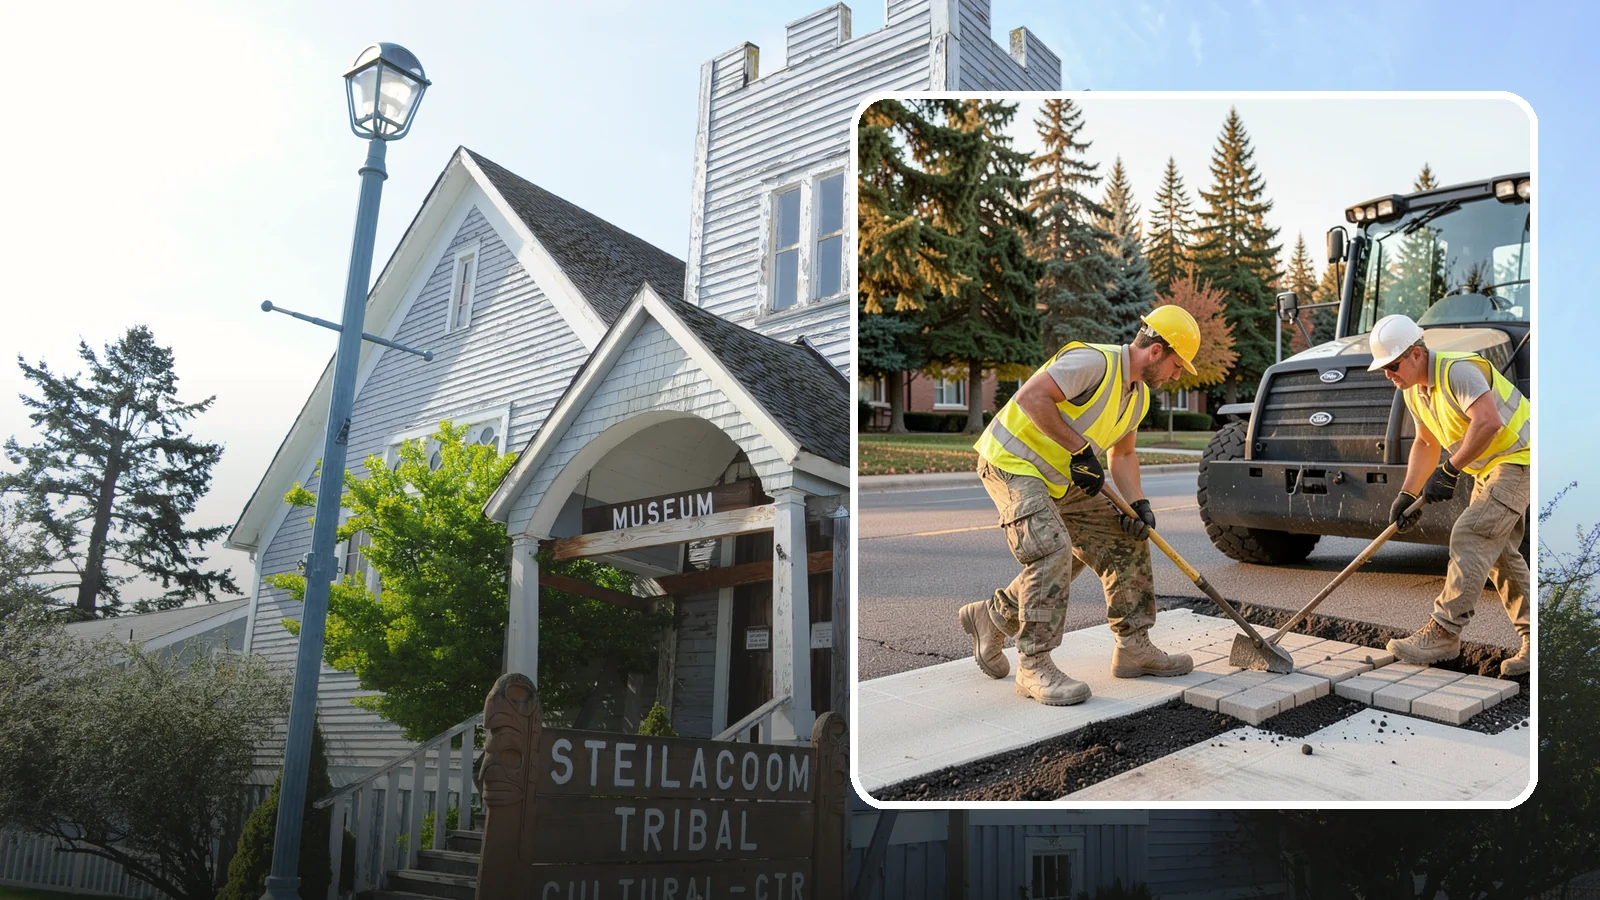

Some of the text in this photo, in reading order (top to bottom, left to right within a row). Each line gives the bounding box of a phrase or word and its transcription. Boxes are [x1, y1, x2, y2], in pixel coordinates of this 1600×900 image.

[612, 491, 714, 531] MUSEUM
[550, 738, 810, 793] STEILACOOM
[614, 806, 758, 852] TRIBAL
